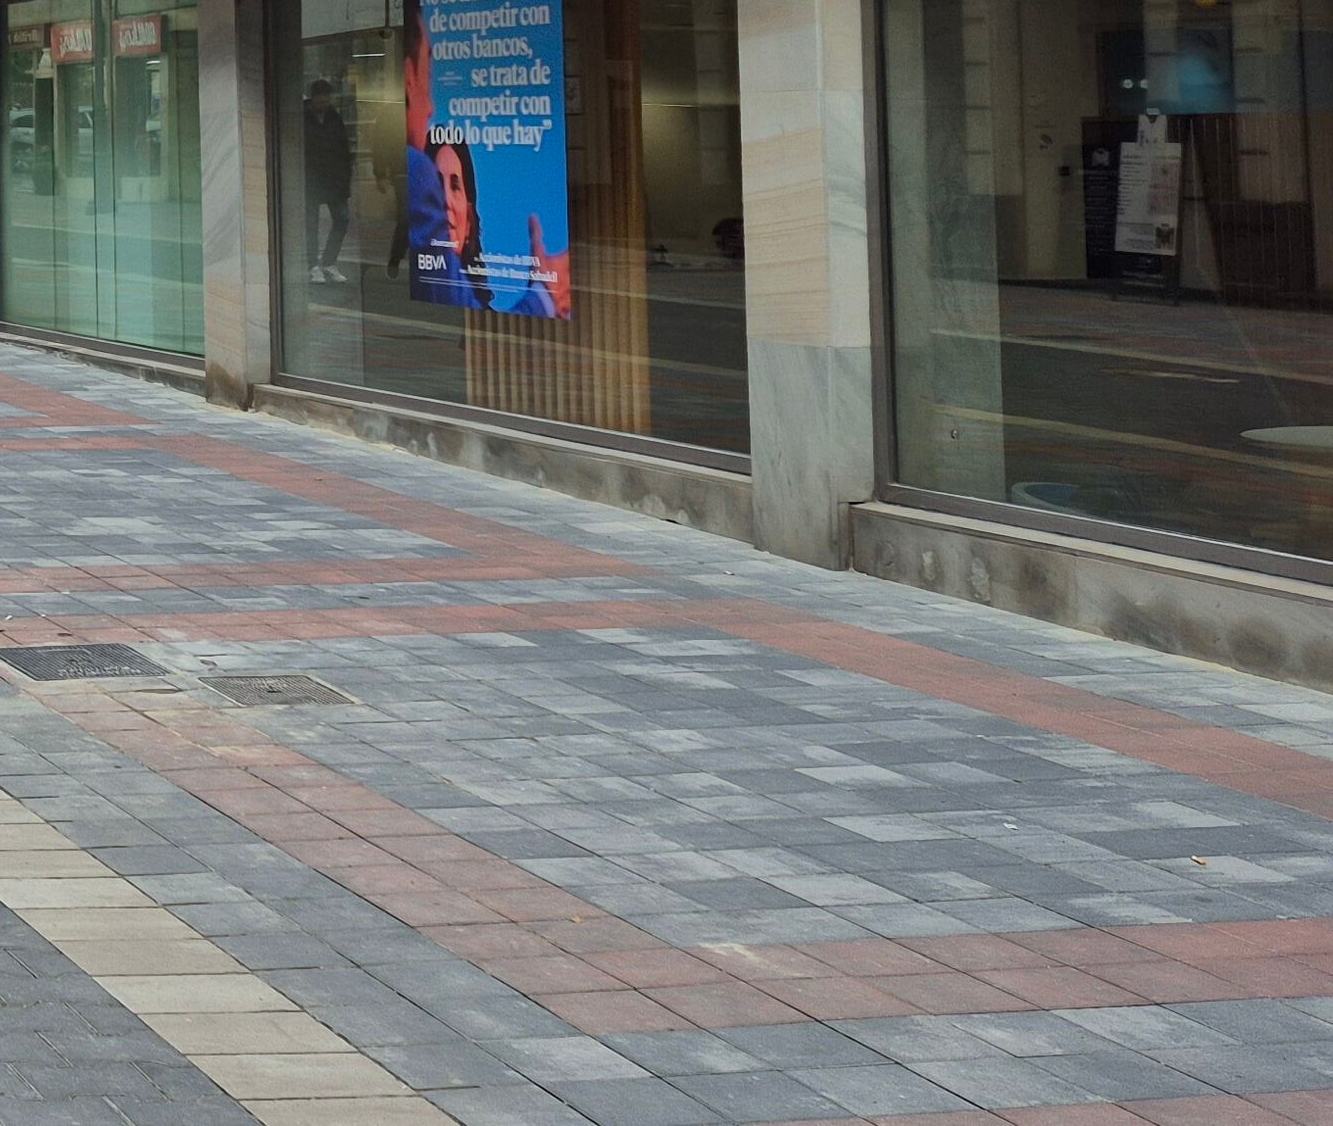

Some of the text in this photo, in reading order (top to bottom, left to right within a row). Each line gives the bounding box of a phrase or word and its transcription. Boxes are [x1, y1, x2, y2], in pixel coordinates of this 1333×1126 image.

[429, 1, 551, 35] de competir con
[432, 33, 533, 61] otros bancos,
[471, 67, 489, 87] se
[490, 64, 528, 86] trata
[529, 58, 551, 85] de
[449, 89, 551, 122] competir con
[430, 120, 464, 145] todo
[464, 119, 481, 145] lo
[482, 125, 512, 152] que
[417, 253, 447, 271] BBVA
